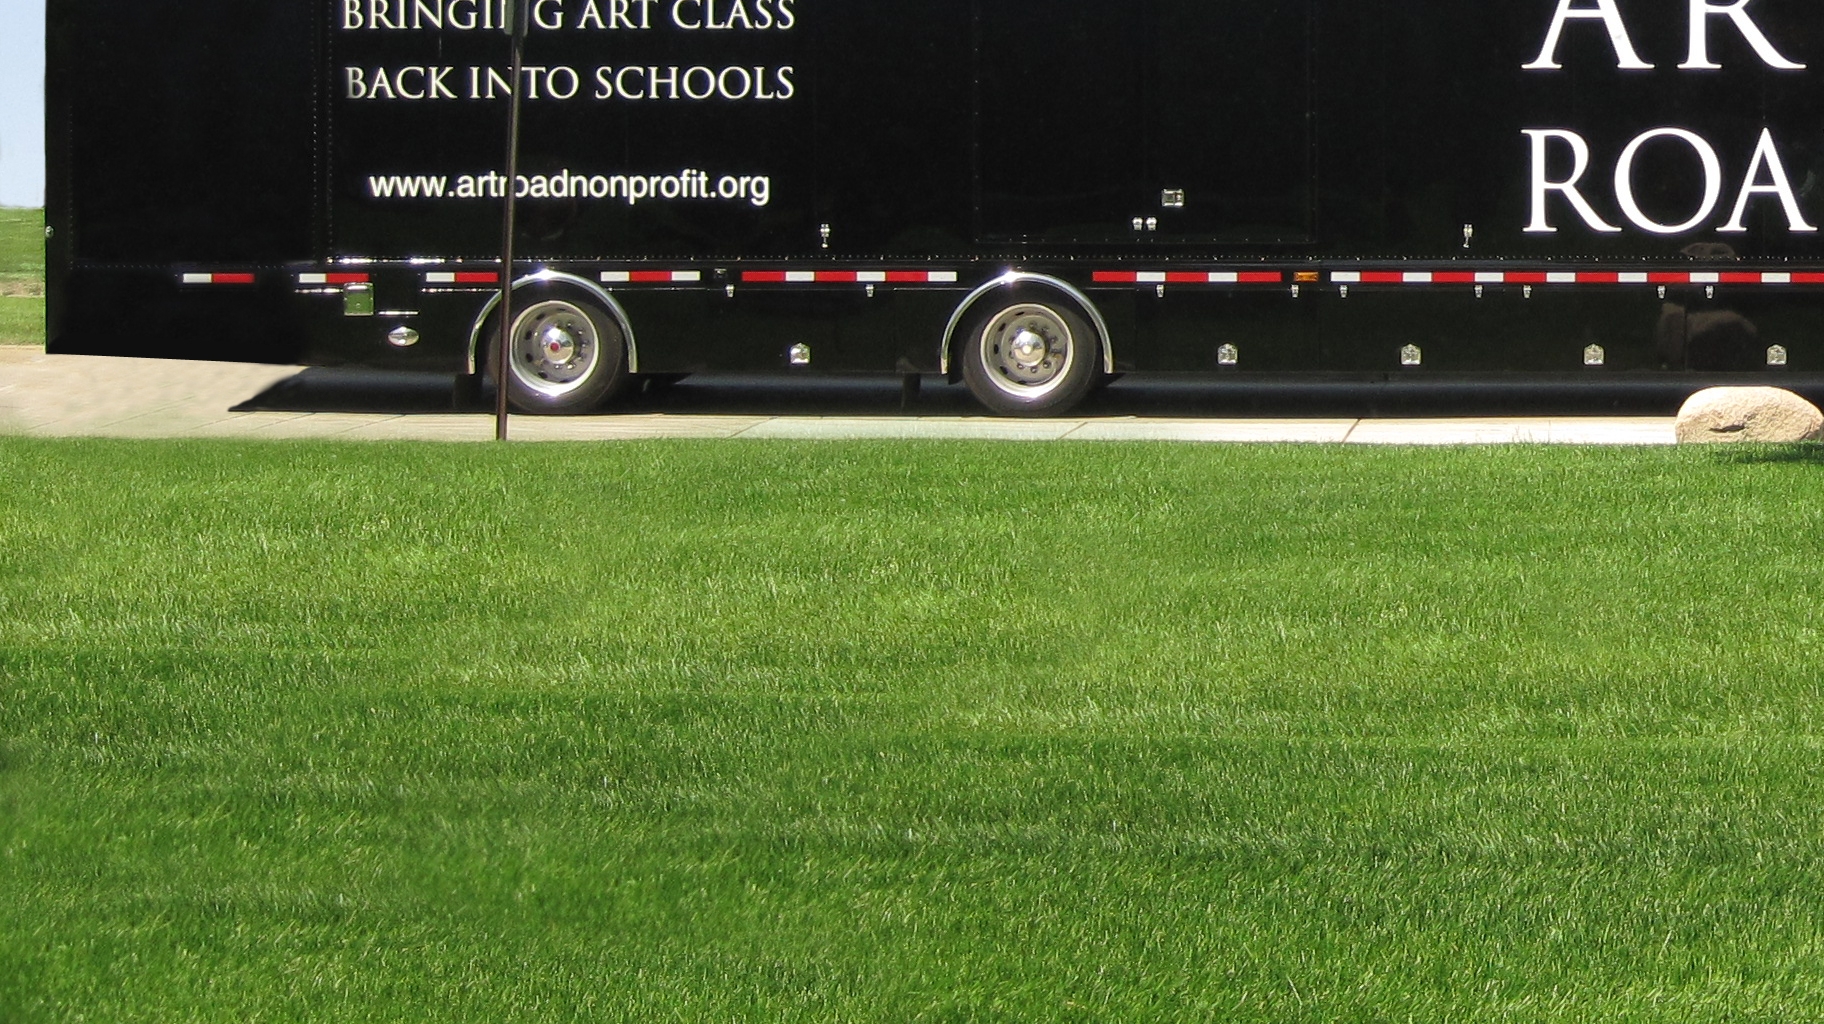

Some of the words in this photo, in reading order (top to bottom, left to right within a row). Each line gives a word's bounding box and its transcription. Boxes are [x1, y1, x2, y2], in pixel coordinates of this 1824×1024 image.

[345, 66, 457, 100] BACK
[470, 66, 580, 100] INTO
[594, 65, 795, 100] SCHOOLS
